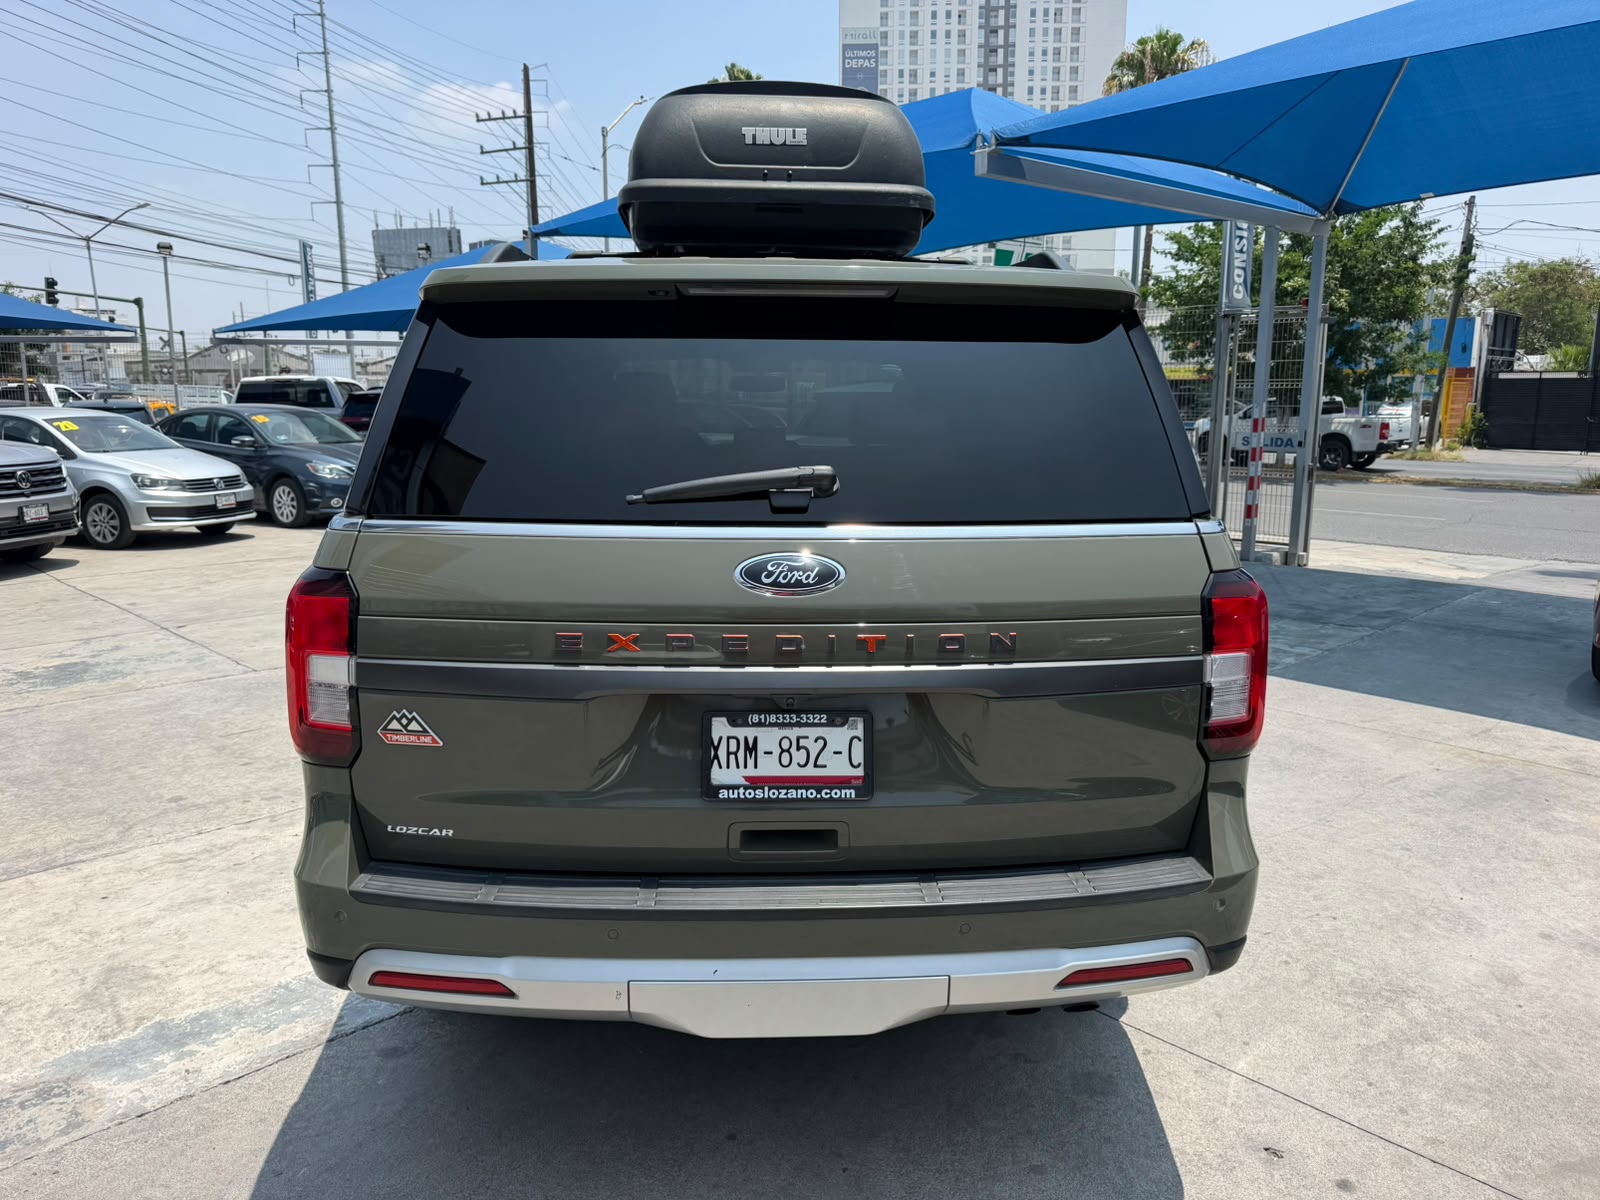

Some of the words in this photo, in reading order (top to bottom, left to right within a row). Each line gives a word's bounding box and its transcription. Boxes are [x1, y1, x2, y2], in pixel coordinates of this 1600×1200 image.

[845, 48, 876, 58] ÚLTIMOS
[845, 58, 876, 68] DEPAS
[741, 127, 808, 145] THULE
[52, 420, 80, 432] 20
[1241, 435, 1295, 448] SLIDA
[761, 560, 818, 584] Ford
[554, 632, 1018, 653] EXPEDITION
[748, 714, 828, 725] (81)8333-3322
[386, 733, 434, 744] TIMBERLINE
[710, 735, 863, 769] XRM-852-C
[718, 786, 856, 799] autoslozano.com
[386, 824, 455, 837] LOZCAR
